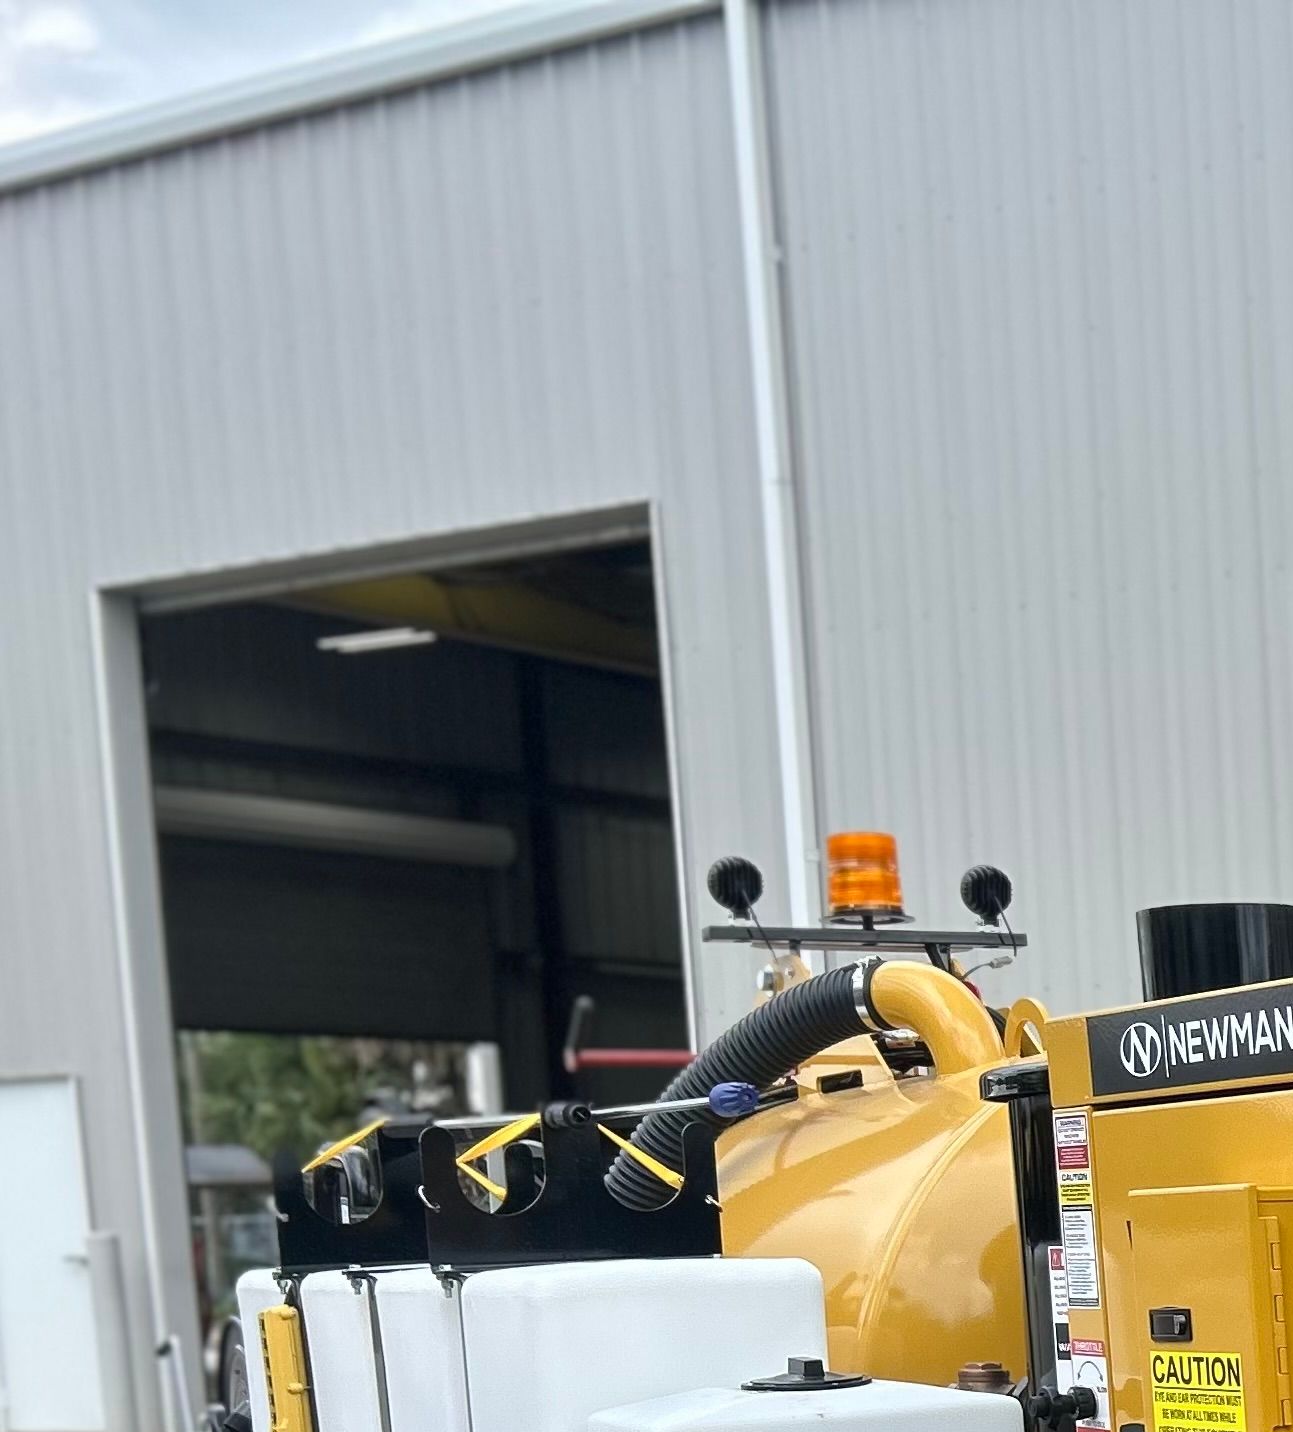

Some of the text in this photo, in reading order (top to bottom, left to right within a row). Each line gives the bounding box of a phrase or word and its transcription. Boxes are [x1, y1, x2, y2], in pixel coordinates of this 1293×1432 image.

[1153, 1355, 1240, 1387] CAUTION
[1155, 1391, 1241, 1407] EYE AND EAR PROTECTION MUST
[1171, 1409, 1185, 1420] WORN
[1193, 1411, 1203, 1421] ALL
[1203, 1411, 1218, 1422] TIMES
[1220, 1412, 1236, 1423] WHILE
